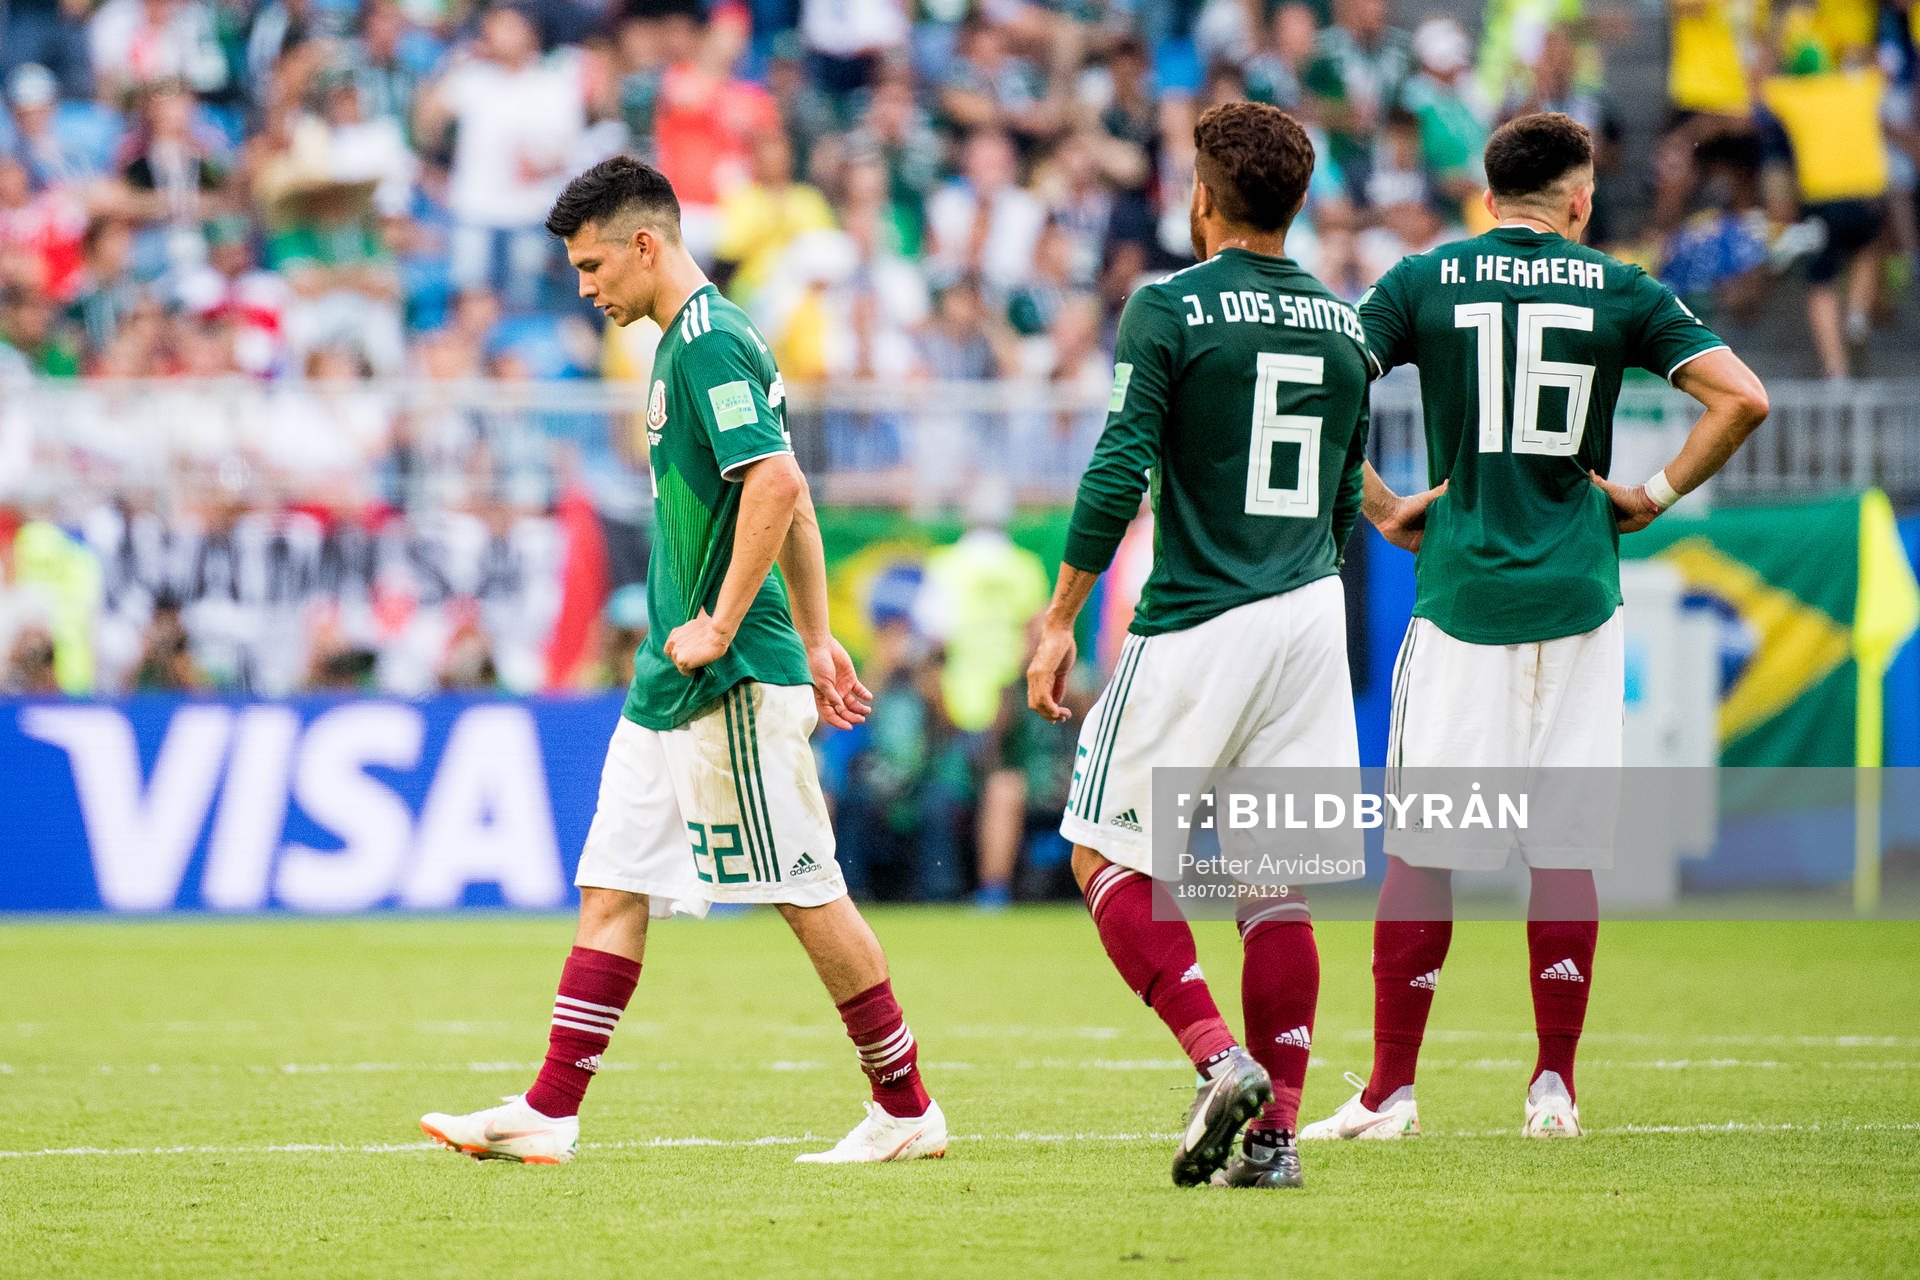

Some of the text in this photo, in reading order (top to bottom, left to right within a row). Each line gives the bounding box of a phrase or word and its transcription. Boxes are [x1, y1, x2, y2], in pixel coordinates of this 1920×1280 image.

[1440, 255, 1604, 290] H. HERRERA
[1182, 291, 1366, 344] J. DOS SANTOS
[1454, 302, 1596, 456] 16
[1244, 352, 1324, 519] 6
[17, 703, 568, 911] VISA
[1110, 818, 1143, 833] adidas
[687, 821, 749, 884] 22
[789, 862, 823, 877] adidas
[1540, 972, 1585, 983] adidas
